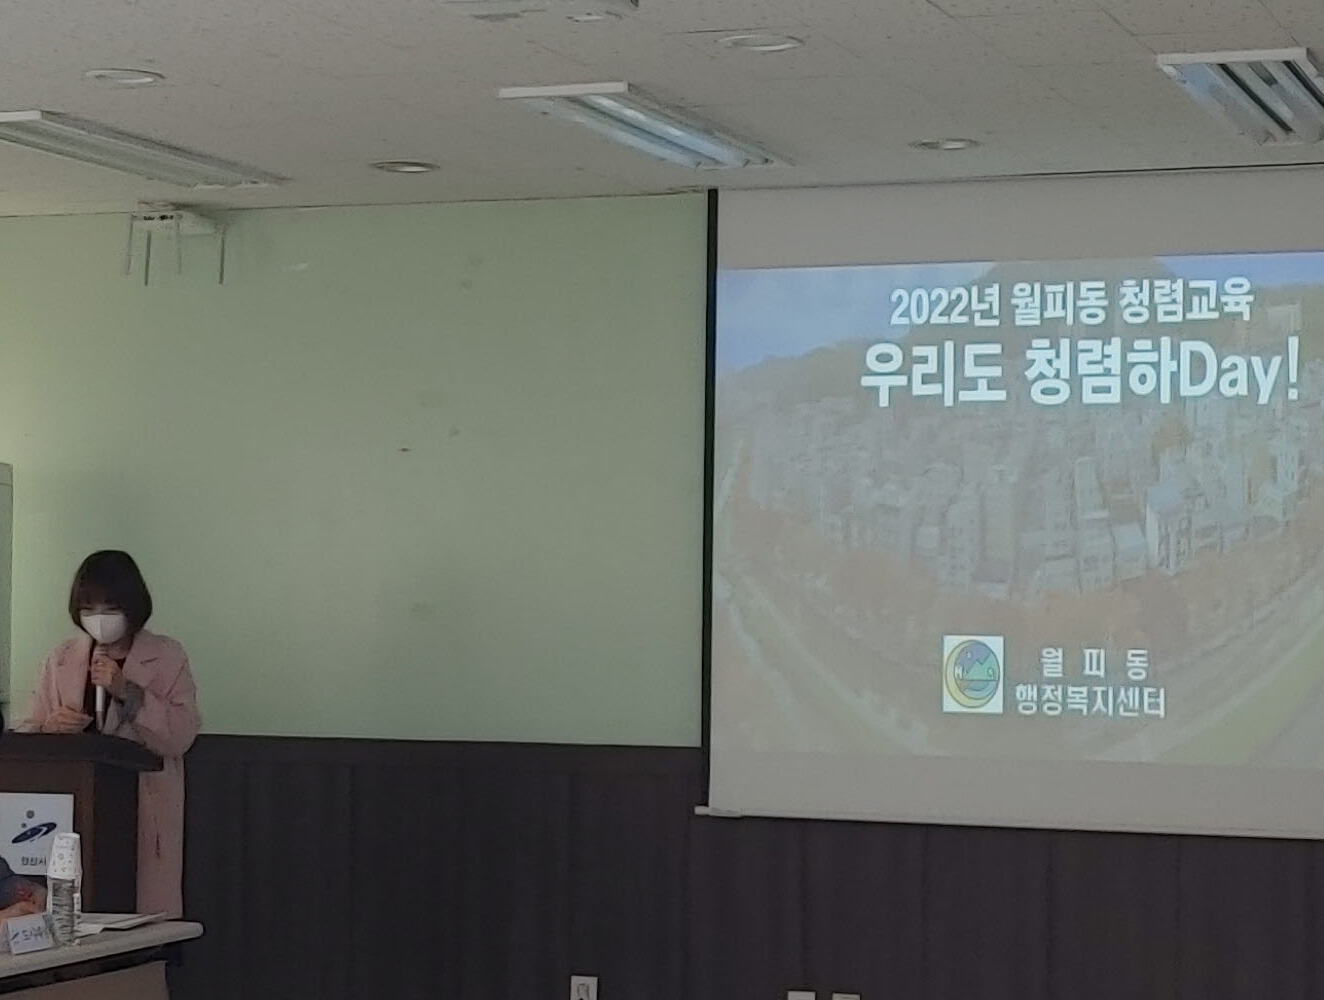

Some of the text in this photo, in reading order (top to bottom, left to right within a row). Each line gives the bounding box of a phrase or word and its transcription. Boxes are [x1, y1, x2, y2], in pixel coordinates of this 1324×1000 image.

[889, 276, 1254, 327] 2022년 월피동 청렴교육
[860, 336, 1300, 407] 우리도 청렴하Day!
[1040, 647, 1149, 681] 월 피 동
[1015, 684, 1166, 718] 행정복지센터
